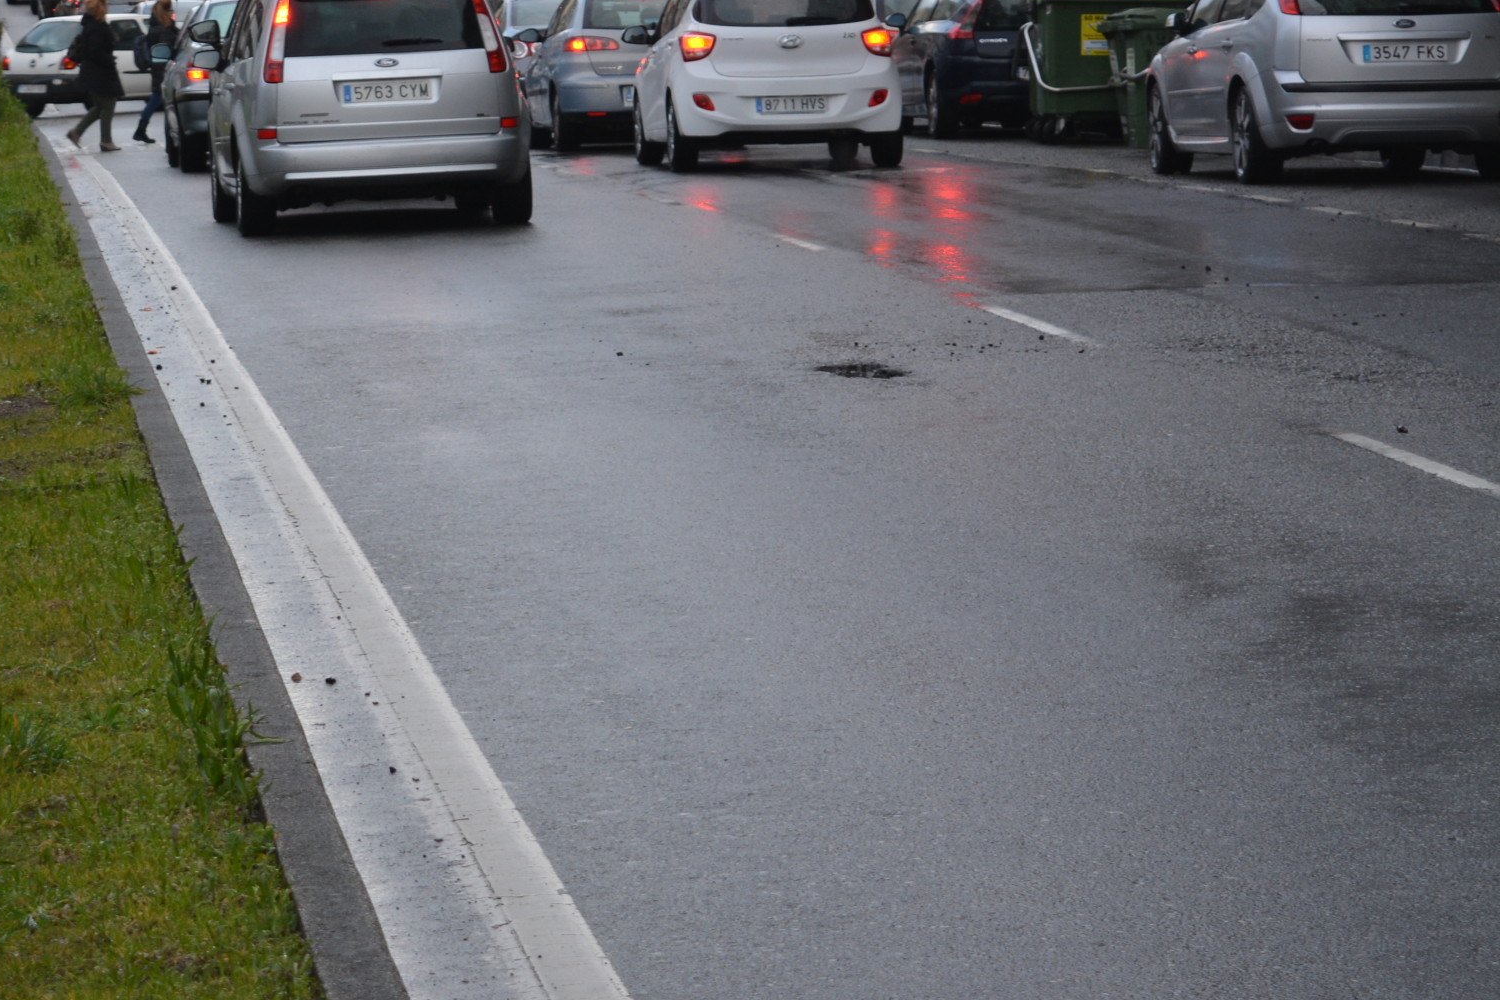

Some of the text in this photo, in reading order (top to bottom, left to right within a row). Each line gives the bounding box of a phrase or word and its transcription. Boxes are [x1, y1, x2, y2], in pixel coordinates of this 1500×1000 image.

[1373, 45, 1445, 60] 3547 FKS
[354, 83, 429, 100] 5763 CYM
[764, 96, 826, 111] 8711 HVS
